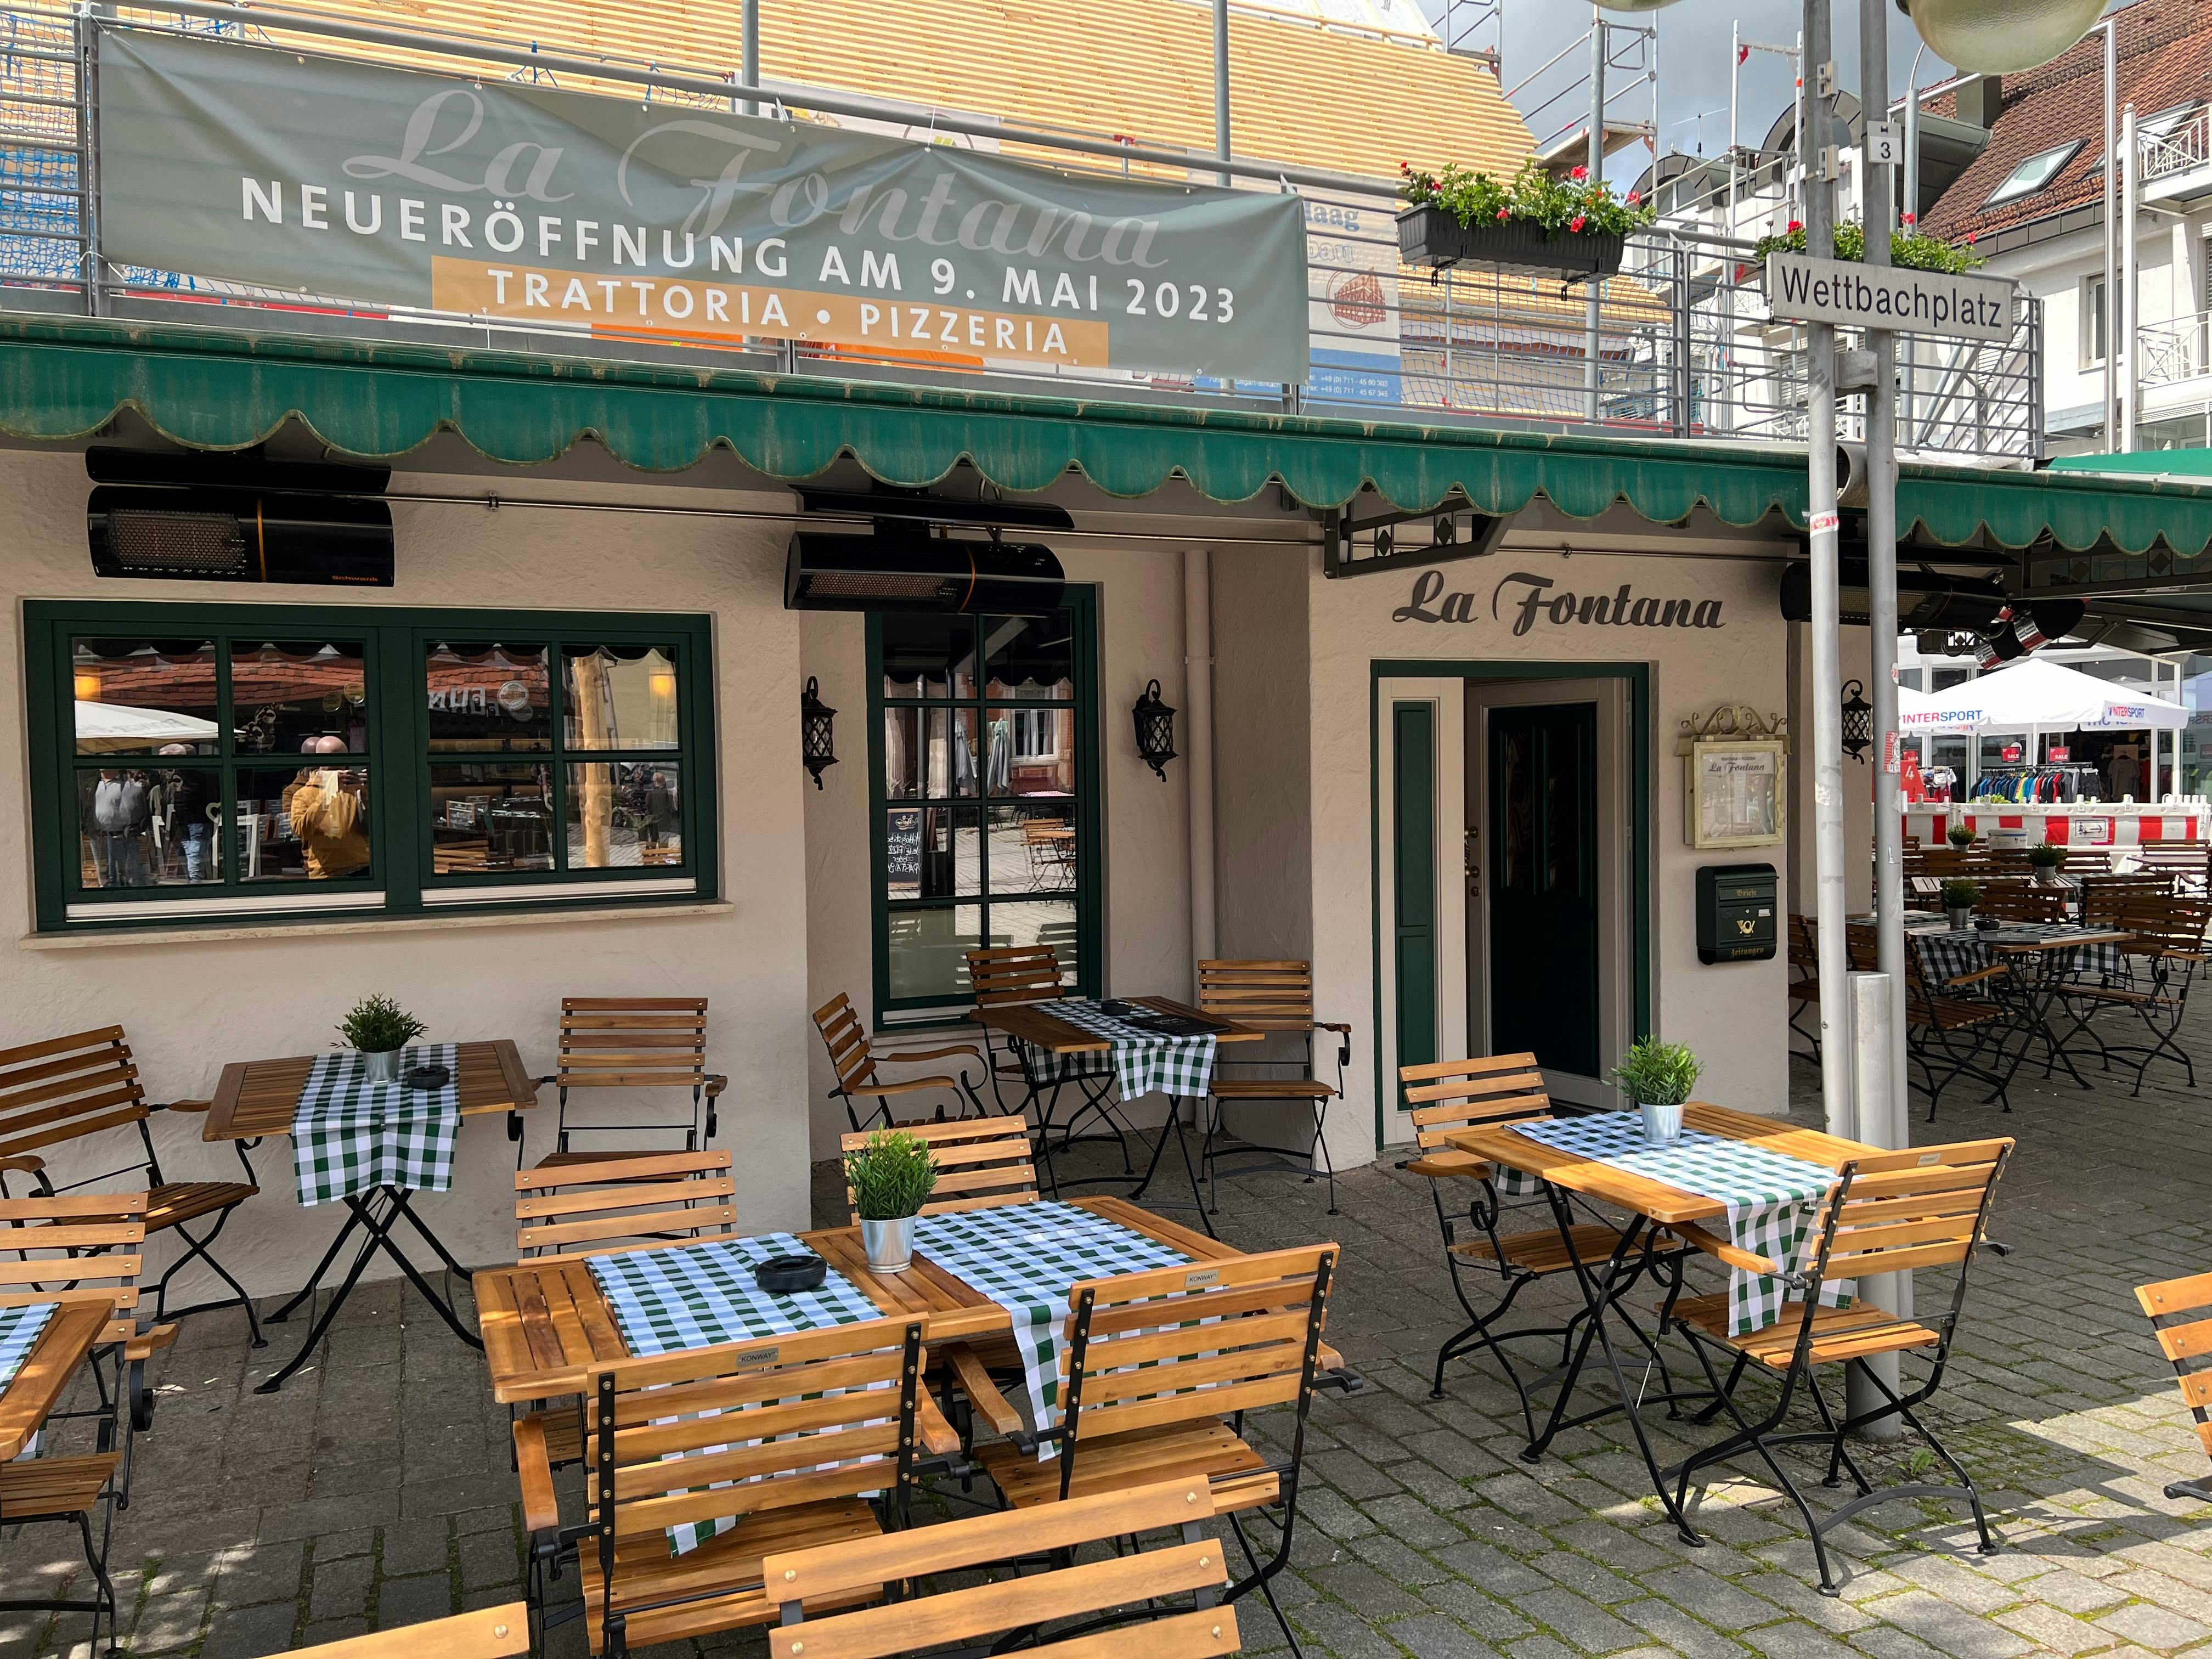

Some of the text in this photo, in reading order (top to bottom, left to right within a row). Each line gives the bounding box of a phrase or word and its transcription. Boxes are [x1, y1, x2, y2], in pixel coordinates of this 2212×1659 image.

[1880, 141, 1891, 159] 3
[342, 89, 1169, 270] La Fontana
[241, 177, 1234, 324] NEUERÖFFNUNG AM 9. MAI 2023
[1781, 266, 2002, 328] Wettbachplatz
[487, 269, 1068, 354] TRATTORIA PIZZERIA
[1392, 570, 1726, 637] La Fontana
[1902, 710, 1983, 724] INTERSPORT
[2112, 704, 2145, 719] INTERSPORT
[1708, 761, 1765, 774] La Fontana
[1905, 765, 1914, 780] 4
[1189, 1273, 1214, 1283] KONWAY
[741, 1352, 772, 1363] KONWAY
